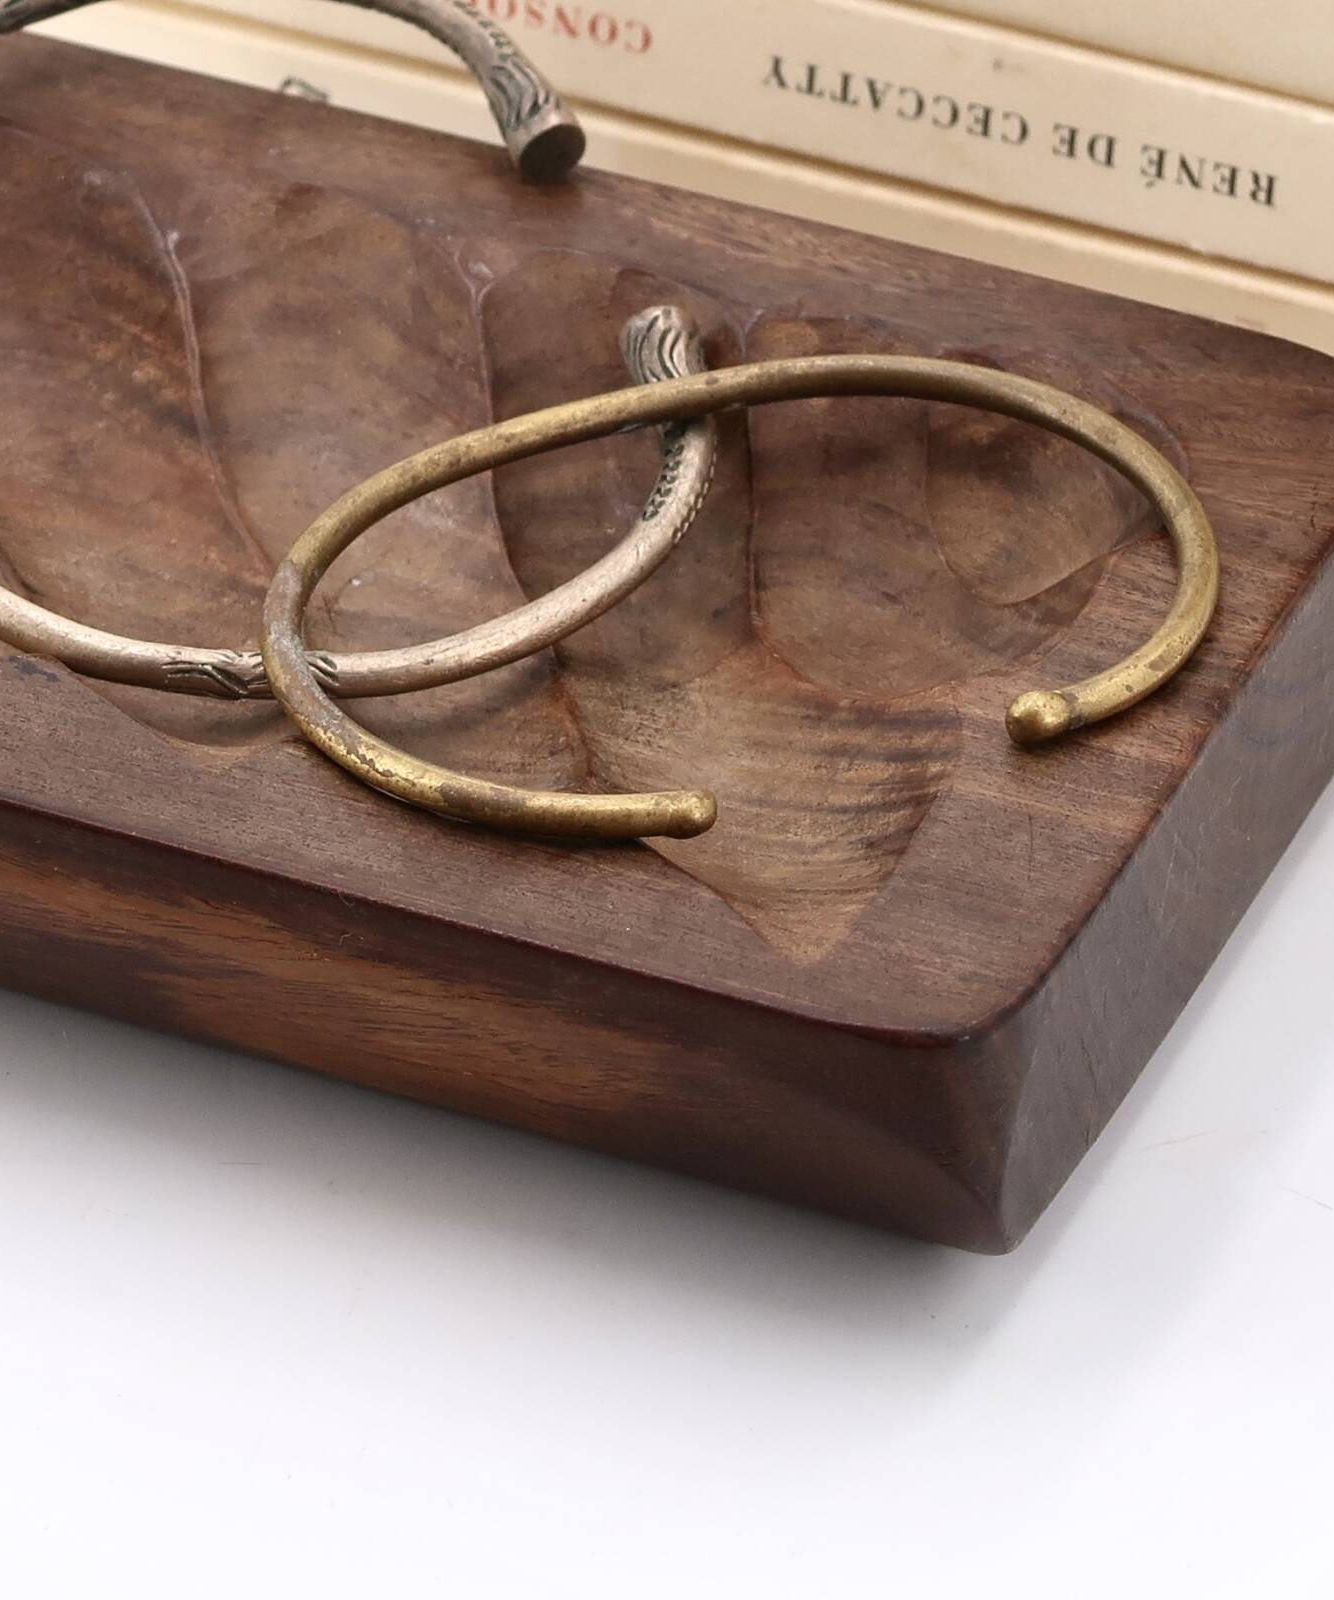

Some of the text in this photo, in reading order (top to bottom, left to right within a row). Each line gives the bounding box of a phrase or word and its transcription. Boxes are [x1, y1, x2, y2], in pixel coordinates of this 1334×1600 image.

[761, 53, 1278, 207] RENÉ DE CECCATTY
